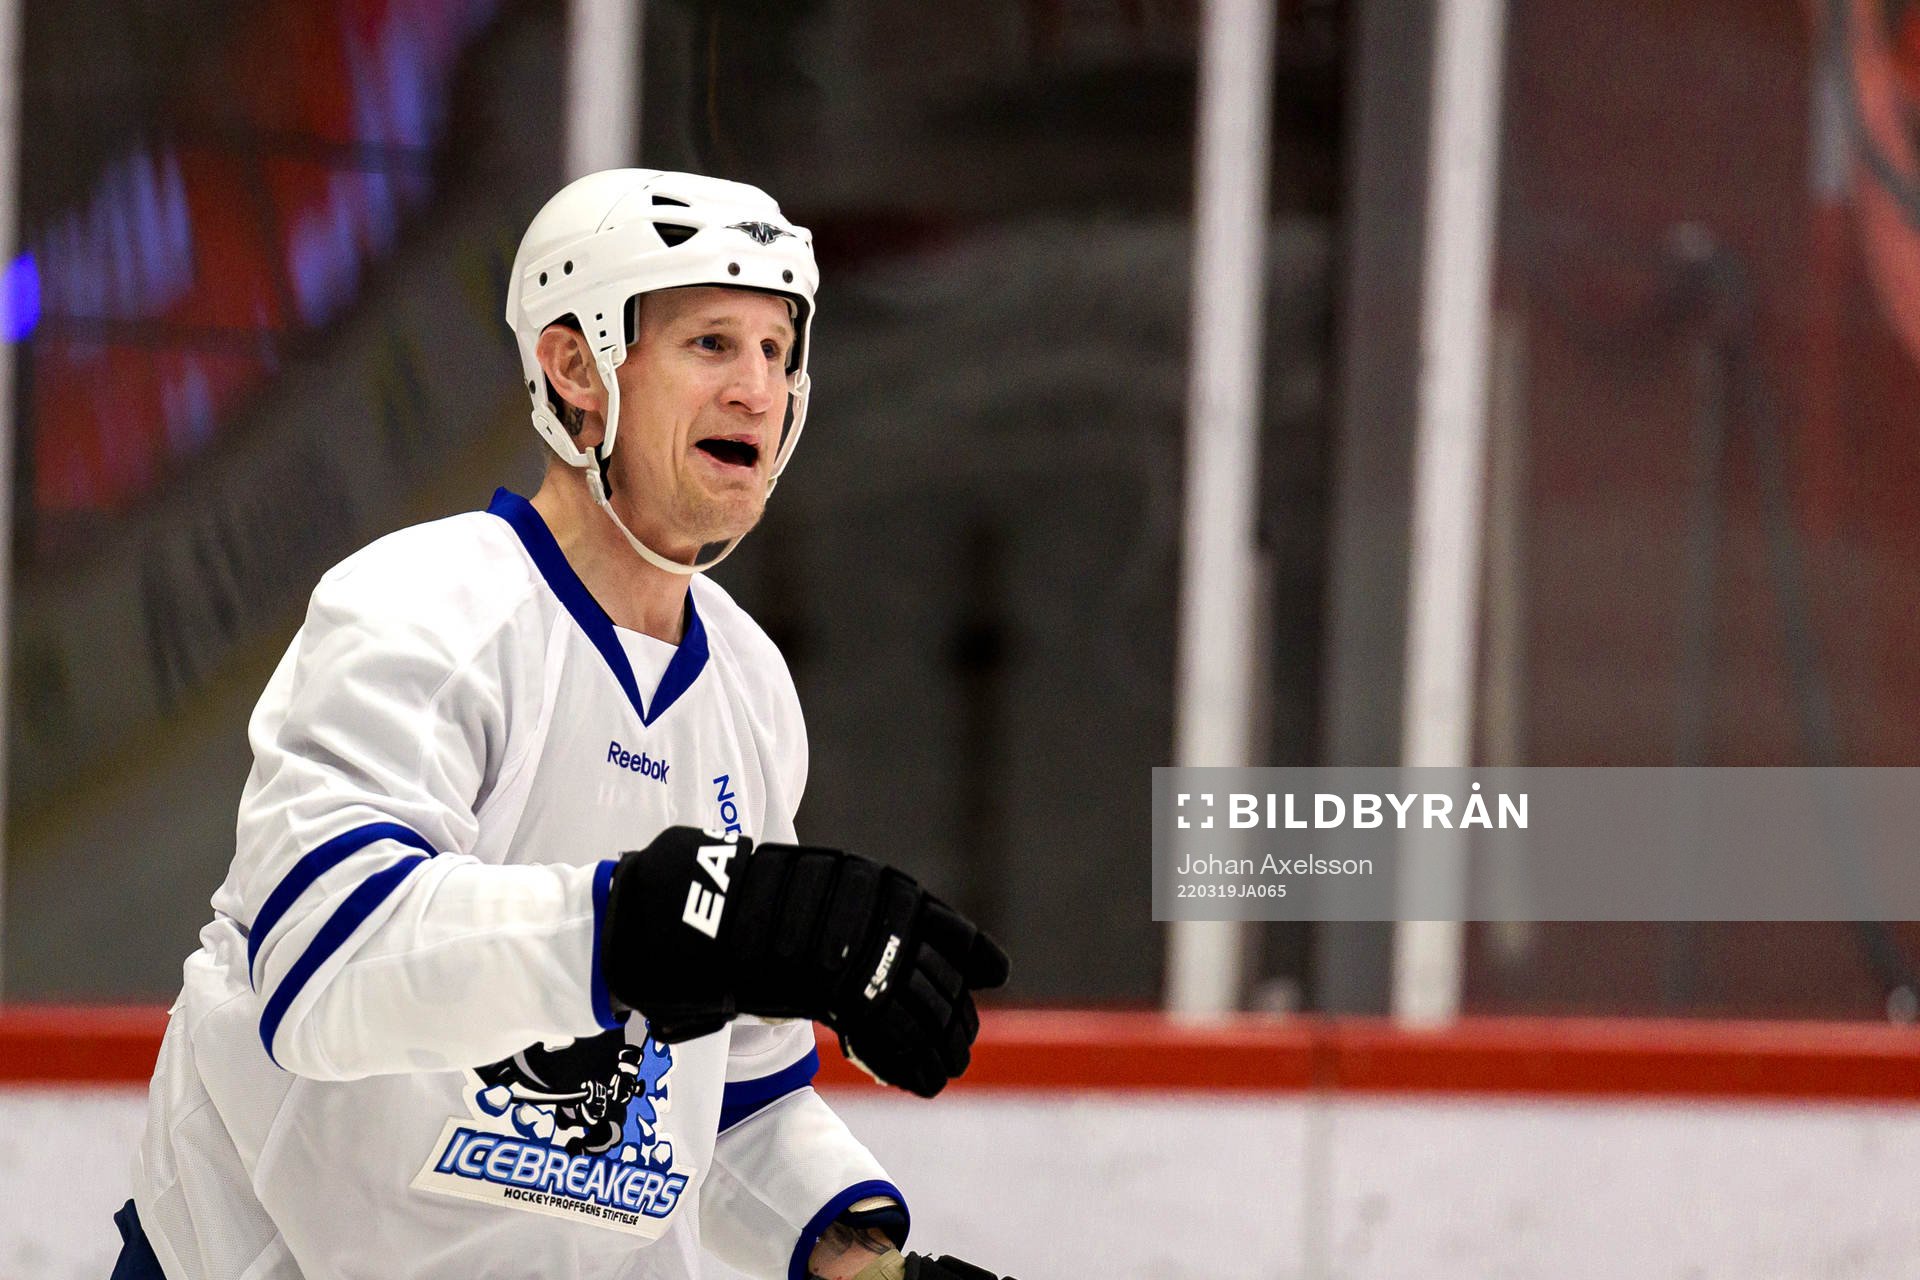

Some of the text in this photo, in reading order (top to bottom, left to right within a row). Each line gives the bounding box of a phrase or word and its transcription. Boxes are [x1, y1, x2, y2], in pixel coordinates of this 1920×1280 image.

[607, 740, 670, 784] Reebok
[682, 827, 739, 939] EA
[435, 1128, 688, 1217] ICEBREAKERS
[504, 1187, 640, 1226] HOCKEYPROFFSENS STIFTELSE
